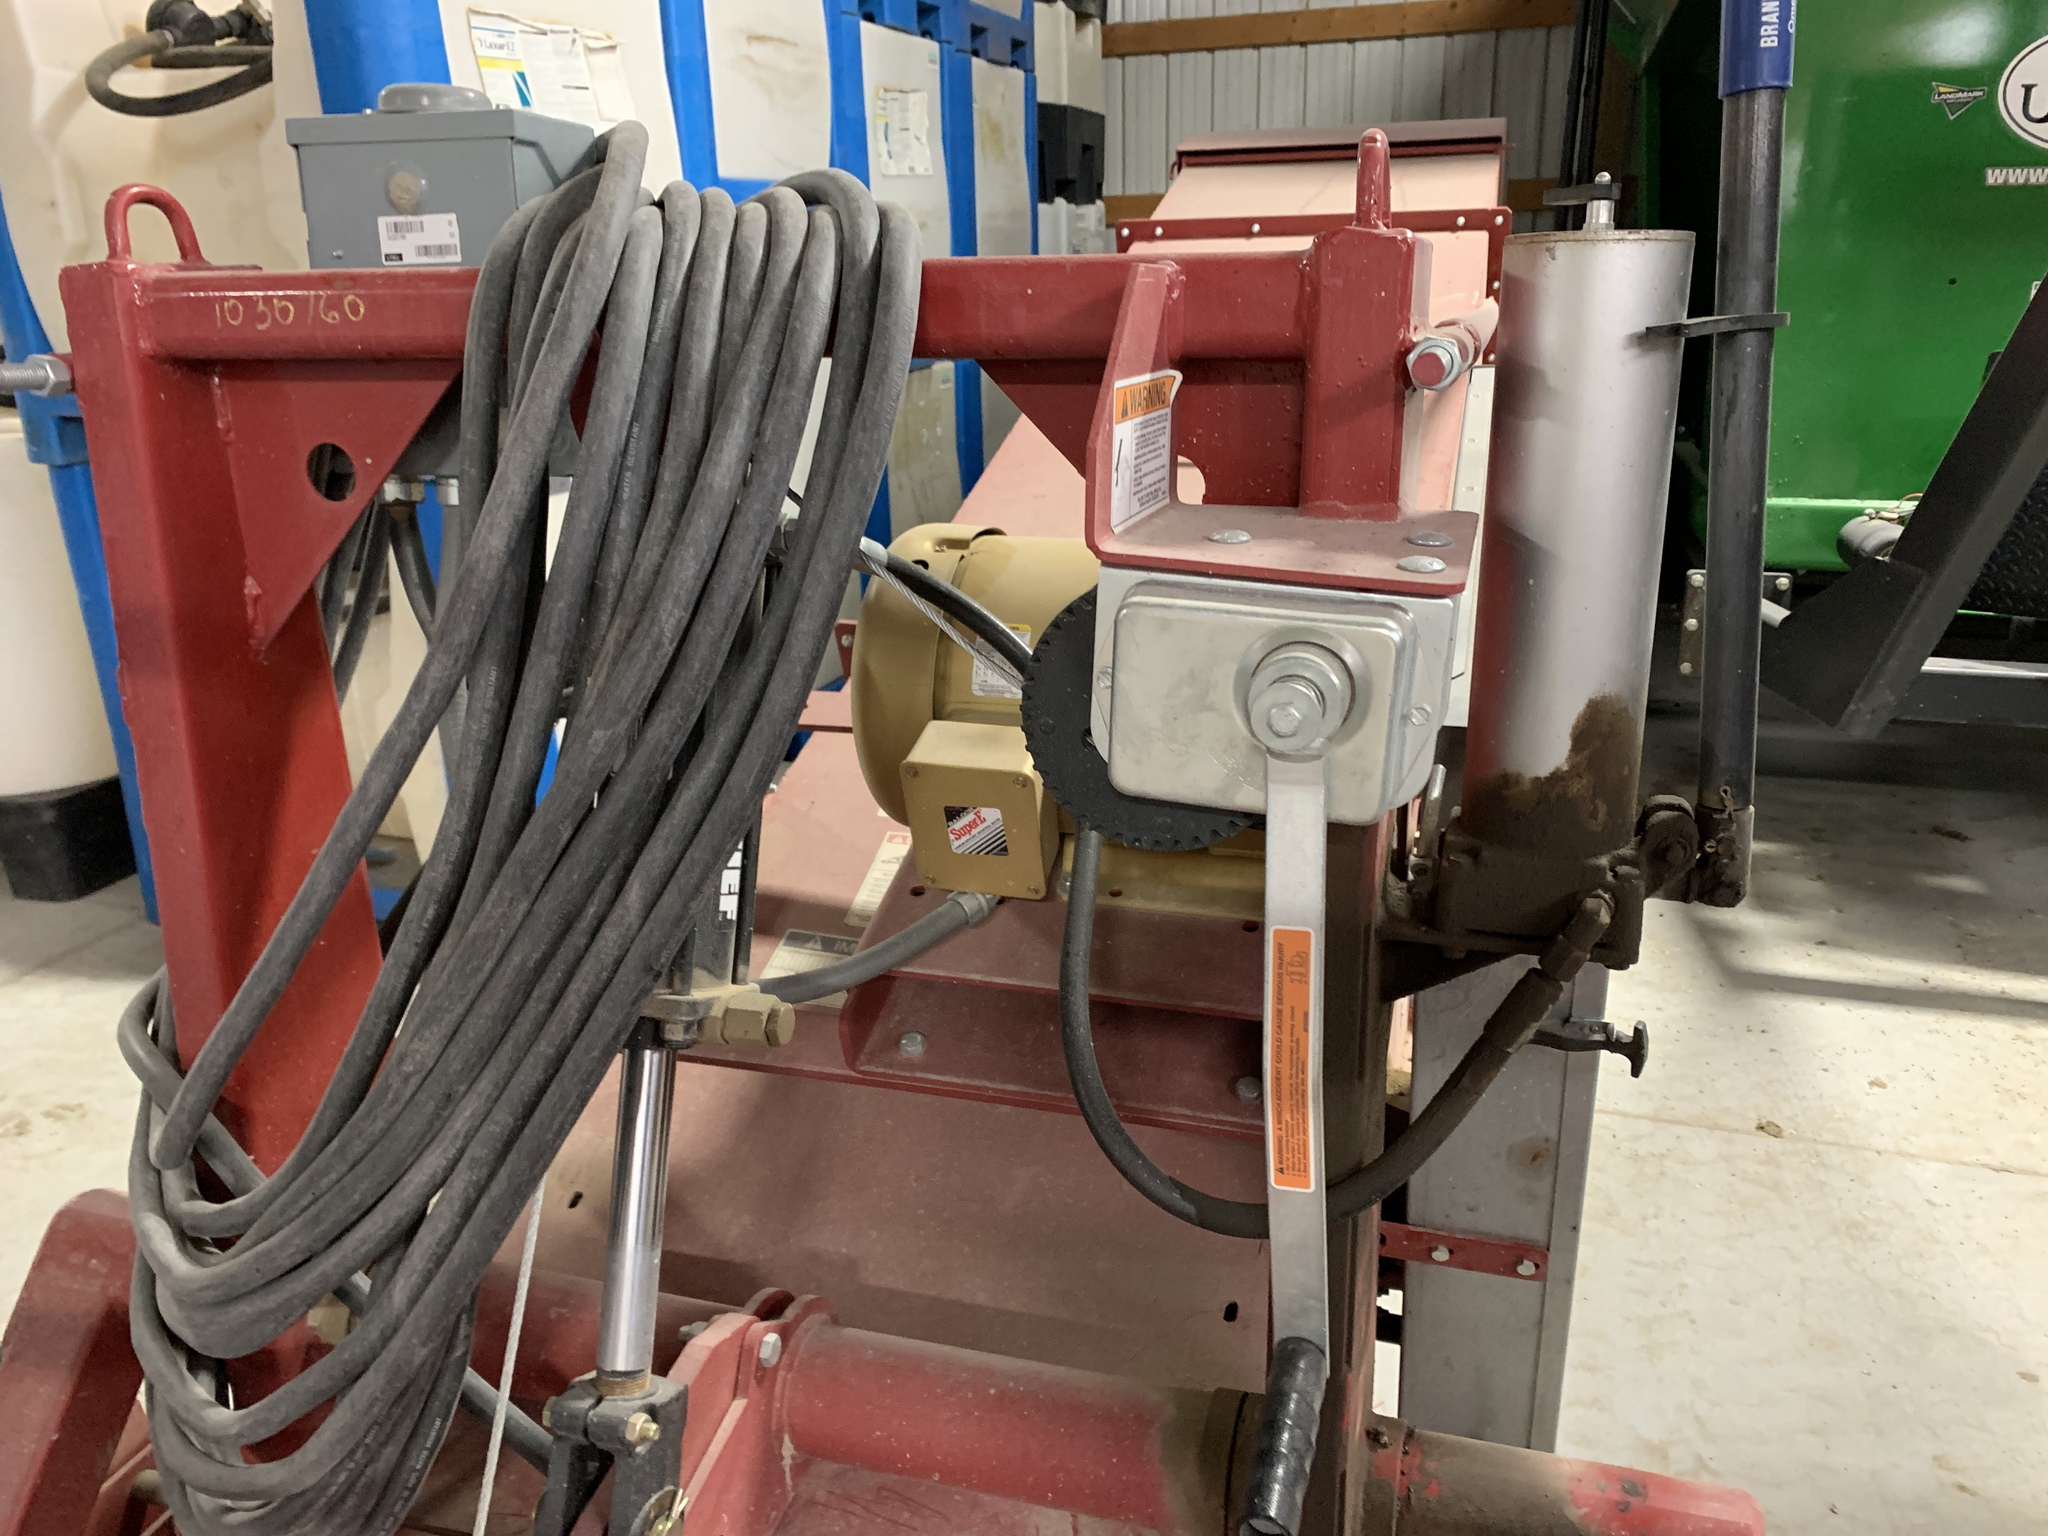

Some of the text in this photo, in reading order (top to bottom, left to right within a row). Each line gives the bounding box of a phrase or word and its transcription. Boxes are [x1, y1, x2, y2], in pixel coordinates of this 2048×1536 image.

[1130, 380, 1166, 415] WARNING
[1276, 942, 1285, 971] INJURY
[1276, 971, 1284, 1006] SERIOUS
[1275, 1007, 1283, 1036] CAUSE
